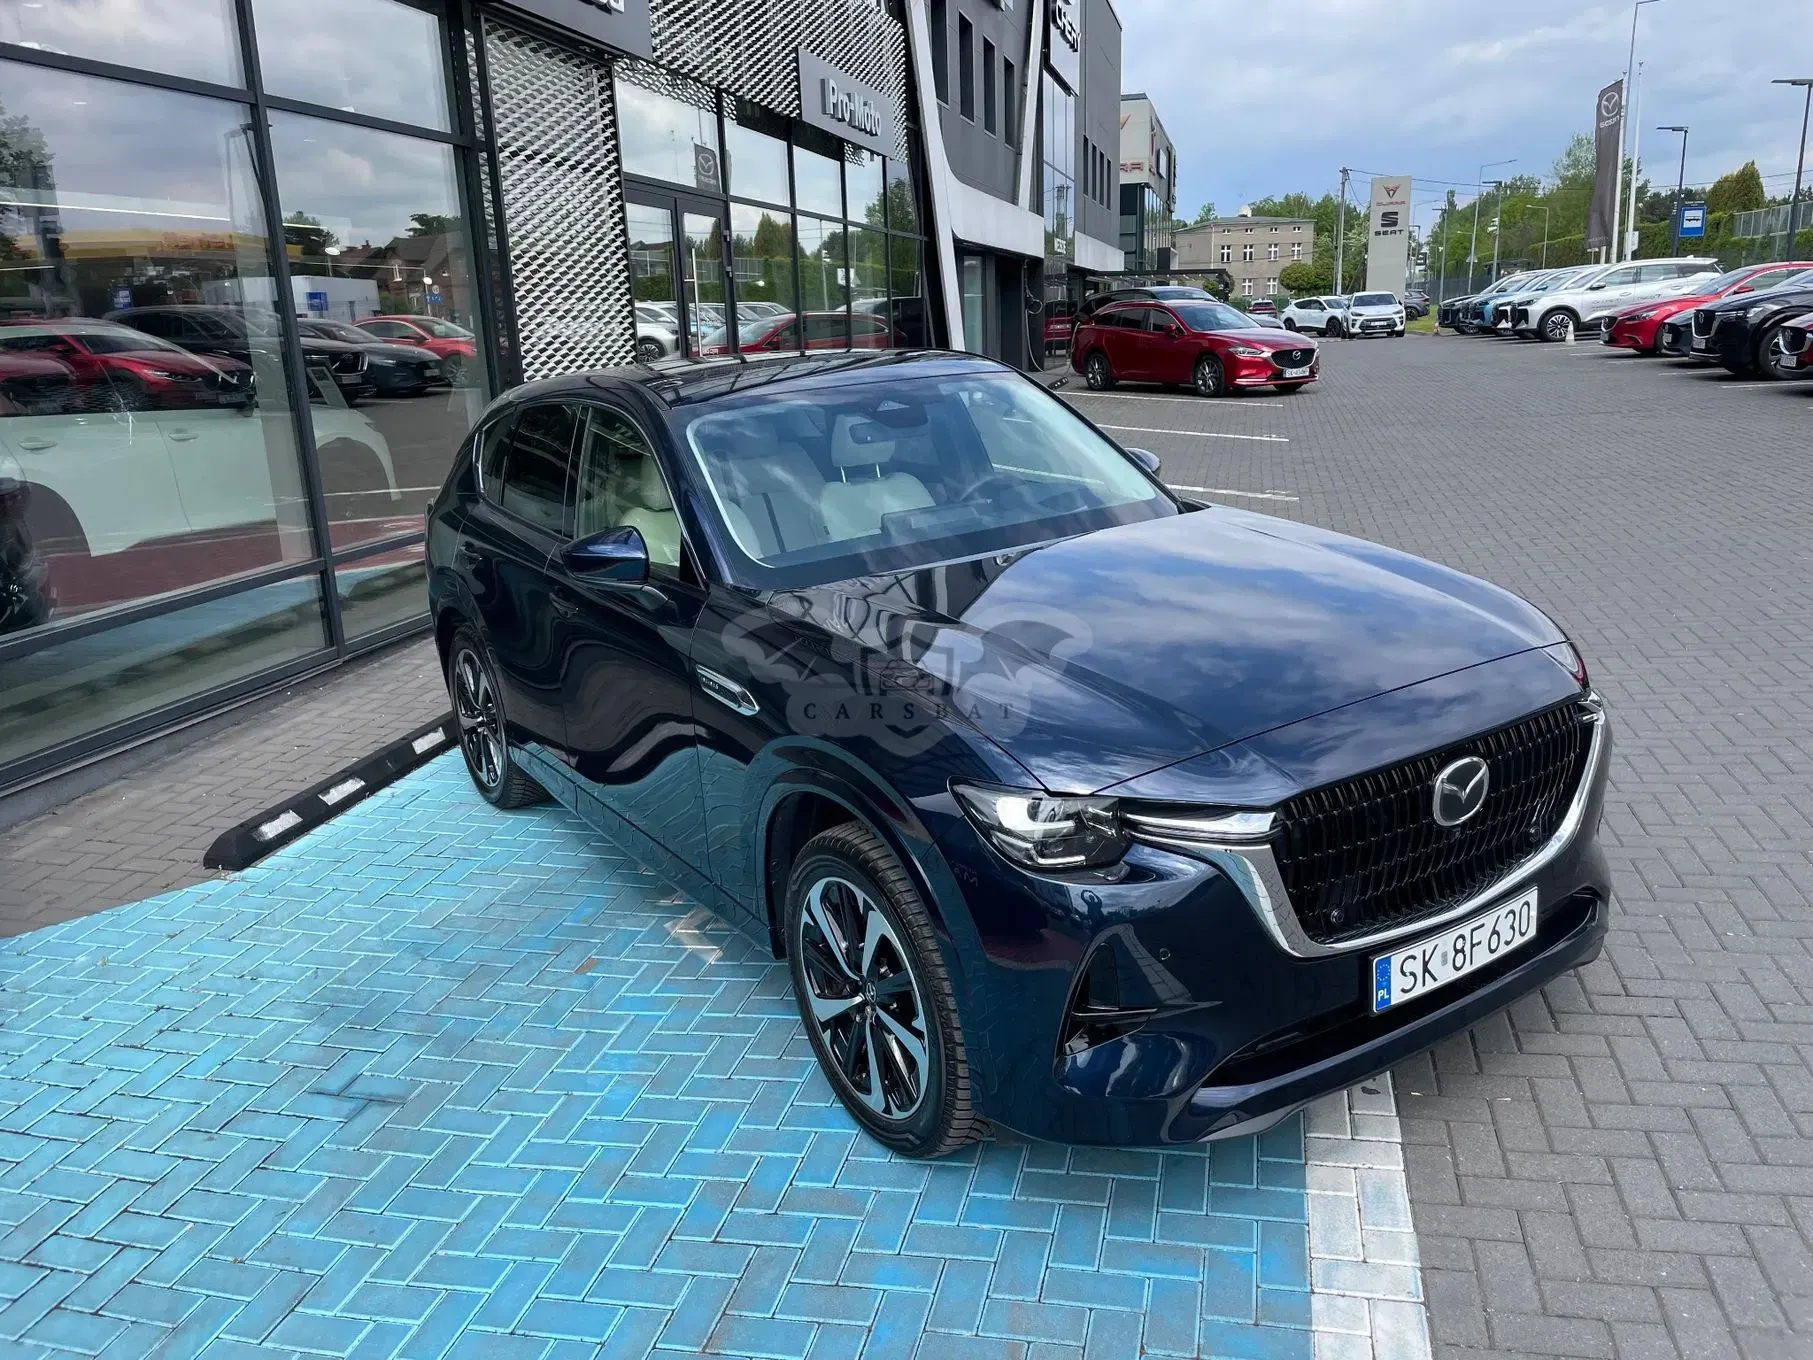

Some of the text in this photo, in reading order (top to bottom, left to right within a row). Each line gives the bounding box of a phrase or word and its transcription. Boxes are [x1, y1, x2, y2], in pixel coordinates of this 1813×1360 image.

[824, 78, 881, 136] Pro-Moto
[1400, 900, 1531, 994] SK 8F630
[1377, 988, 1390, 1002] PL
